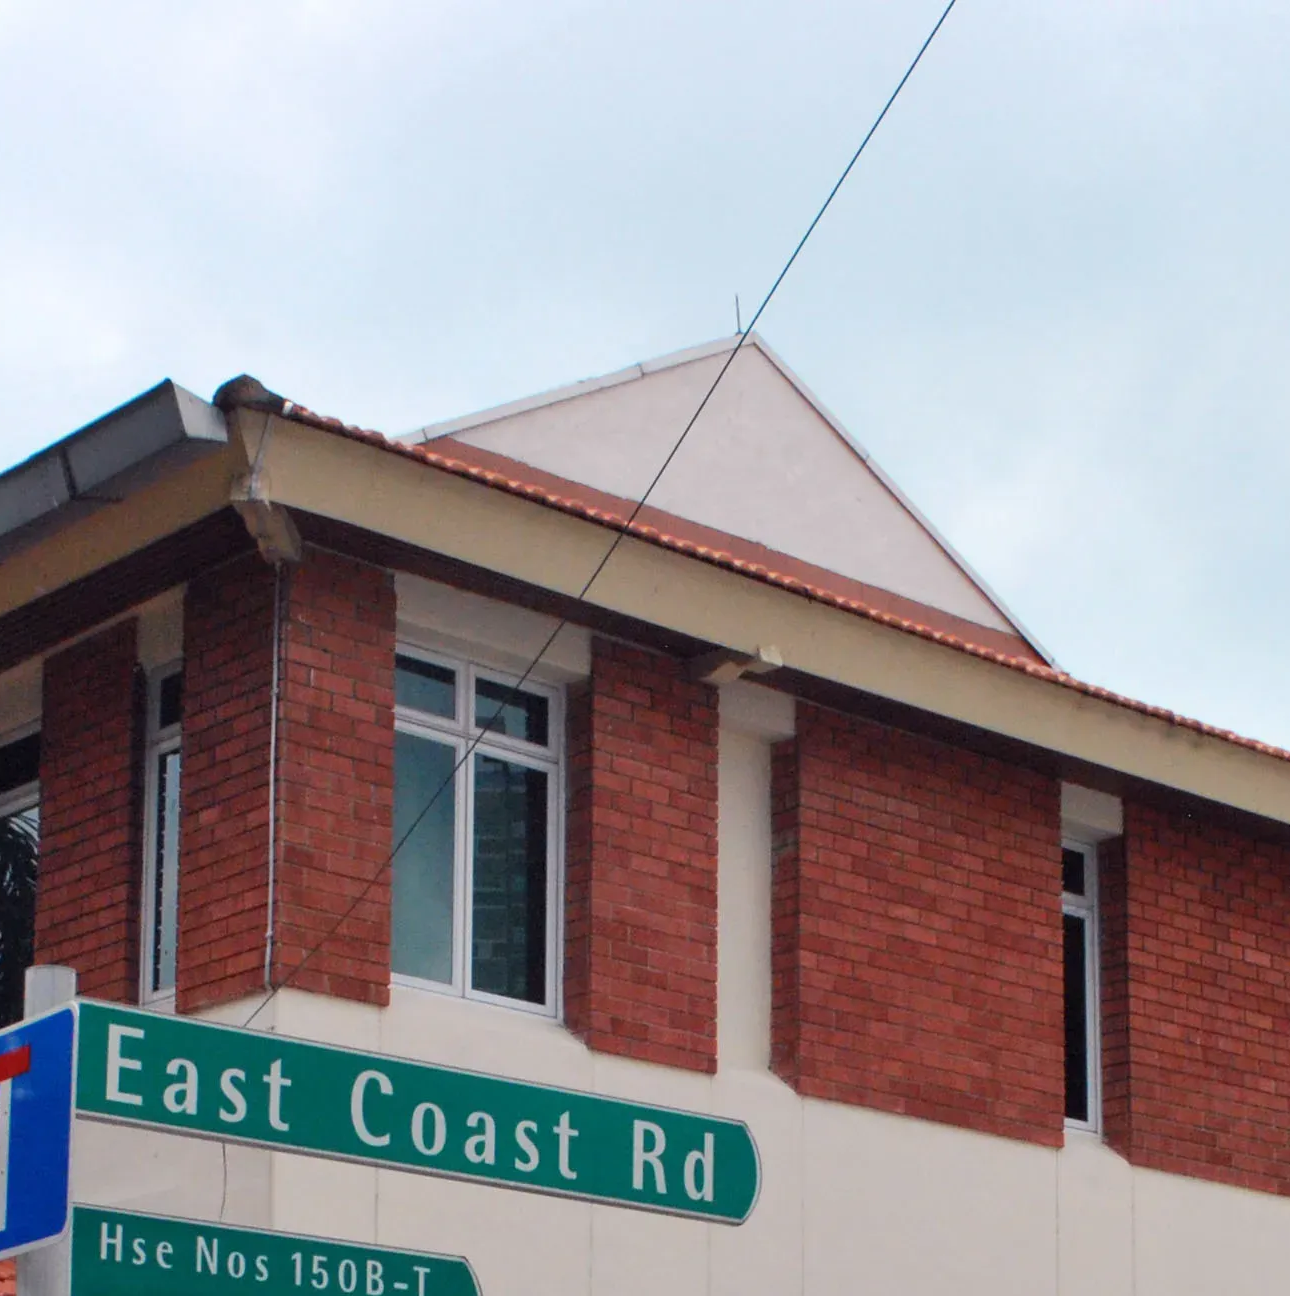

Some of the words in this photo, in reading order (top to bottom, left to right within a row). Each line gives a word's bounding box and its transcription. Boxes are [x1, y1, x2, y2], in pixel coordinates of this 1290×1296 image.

[106, 1022, 293, 1134] East
[350, 1068, 580, 1182] Coast
[632, 1118, 716, 1203] Rd
[99, 1223, 175, 1271] Hse
[195, 1236, 271, 1284] Nos
